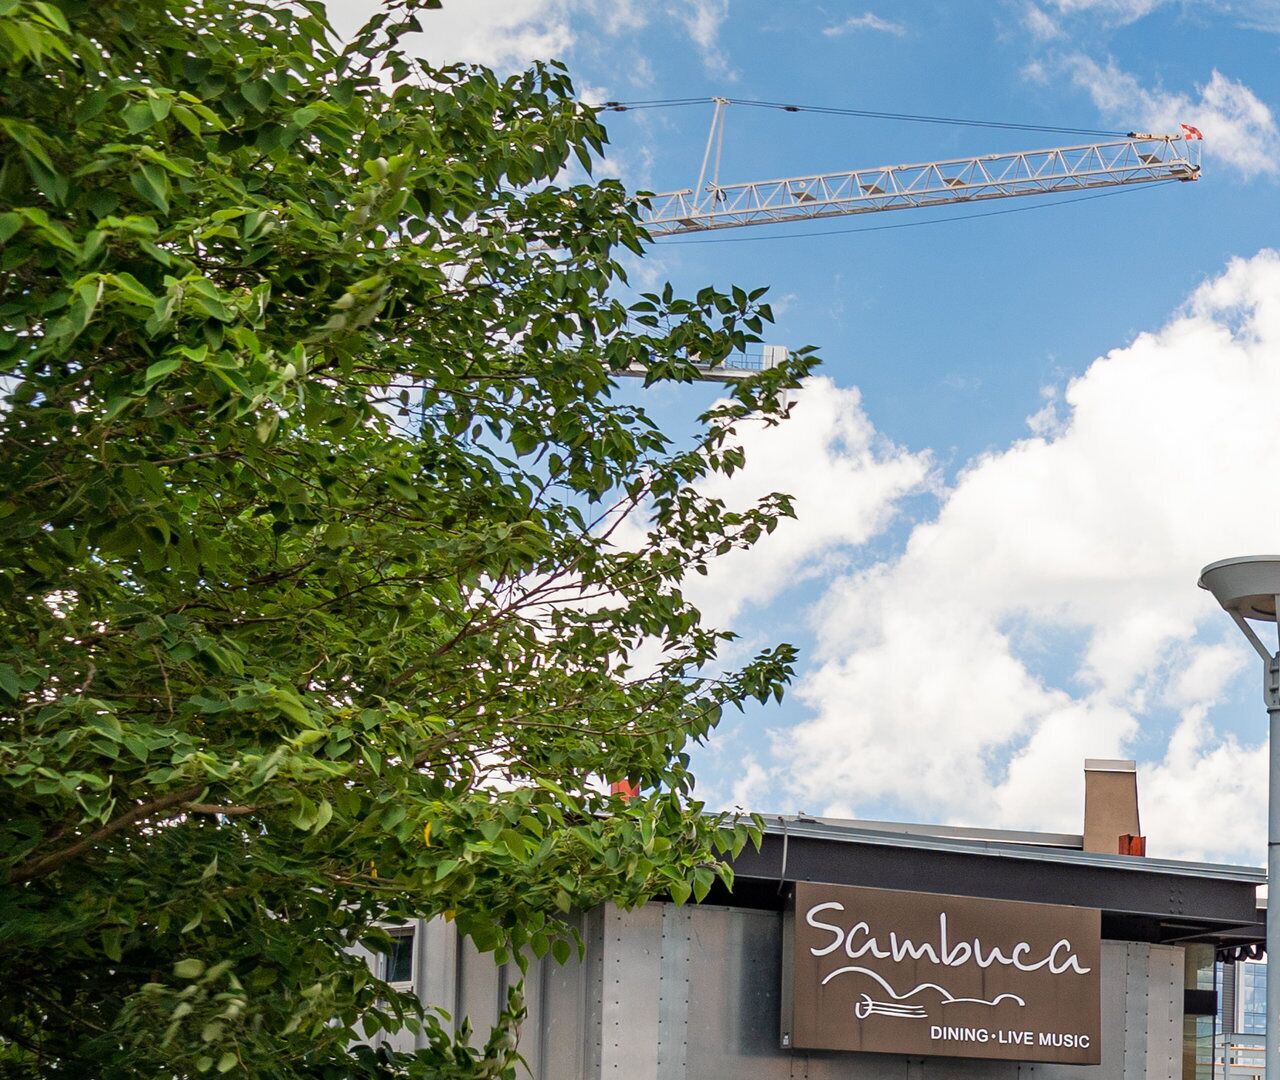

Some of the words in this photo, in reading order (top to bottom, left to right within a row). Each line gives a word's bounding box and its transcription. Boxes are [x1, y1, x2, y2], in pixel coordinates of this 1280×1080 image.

[806, 901, 1091, 975] Sambuca
[930, 1025, 989, 1042] DINING
[998, 1030, 1034, 1045] LIVE
[1038, 1032, 1090, 1048] MUSIC
